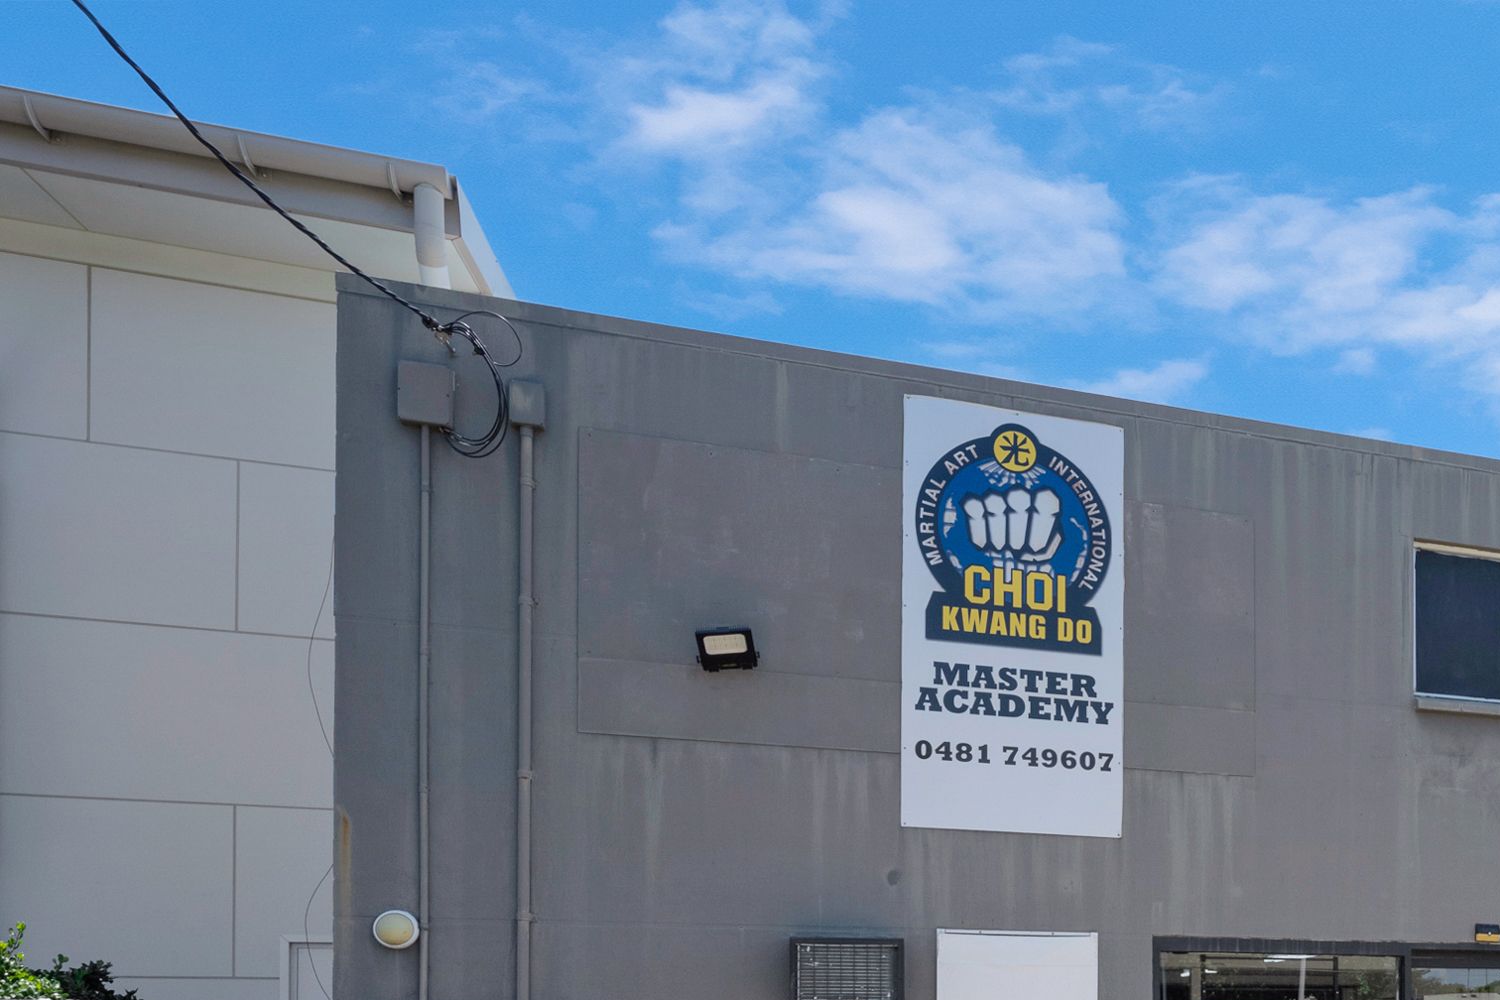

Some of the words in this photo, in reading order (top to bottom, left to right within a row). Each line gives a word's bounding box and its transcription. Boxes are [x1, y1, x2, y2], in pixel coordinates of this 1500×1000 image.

[918, 476, 946, 566] MARTIAL
[944, 443, 979, 470] ART
[1049, 456, 1106, 591] INTERNATIONAL
[963, 564, 1067, 613] CHOI
[942, 604, 1047, 640] KWANG
[1057, 617, 1093, 645] DO
[933, 660, 1097, 698] MASTER
[915, 687, 1114, 725] ACADEMY
[914, 740, 991, 765] 0481
[1003, 746, 1114, 772] 749607
